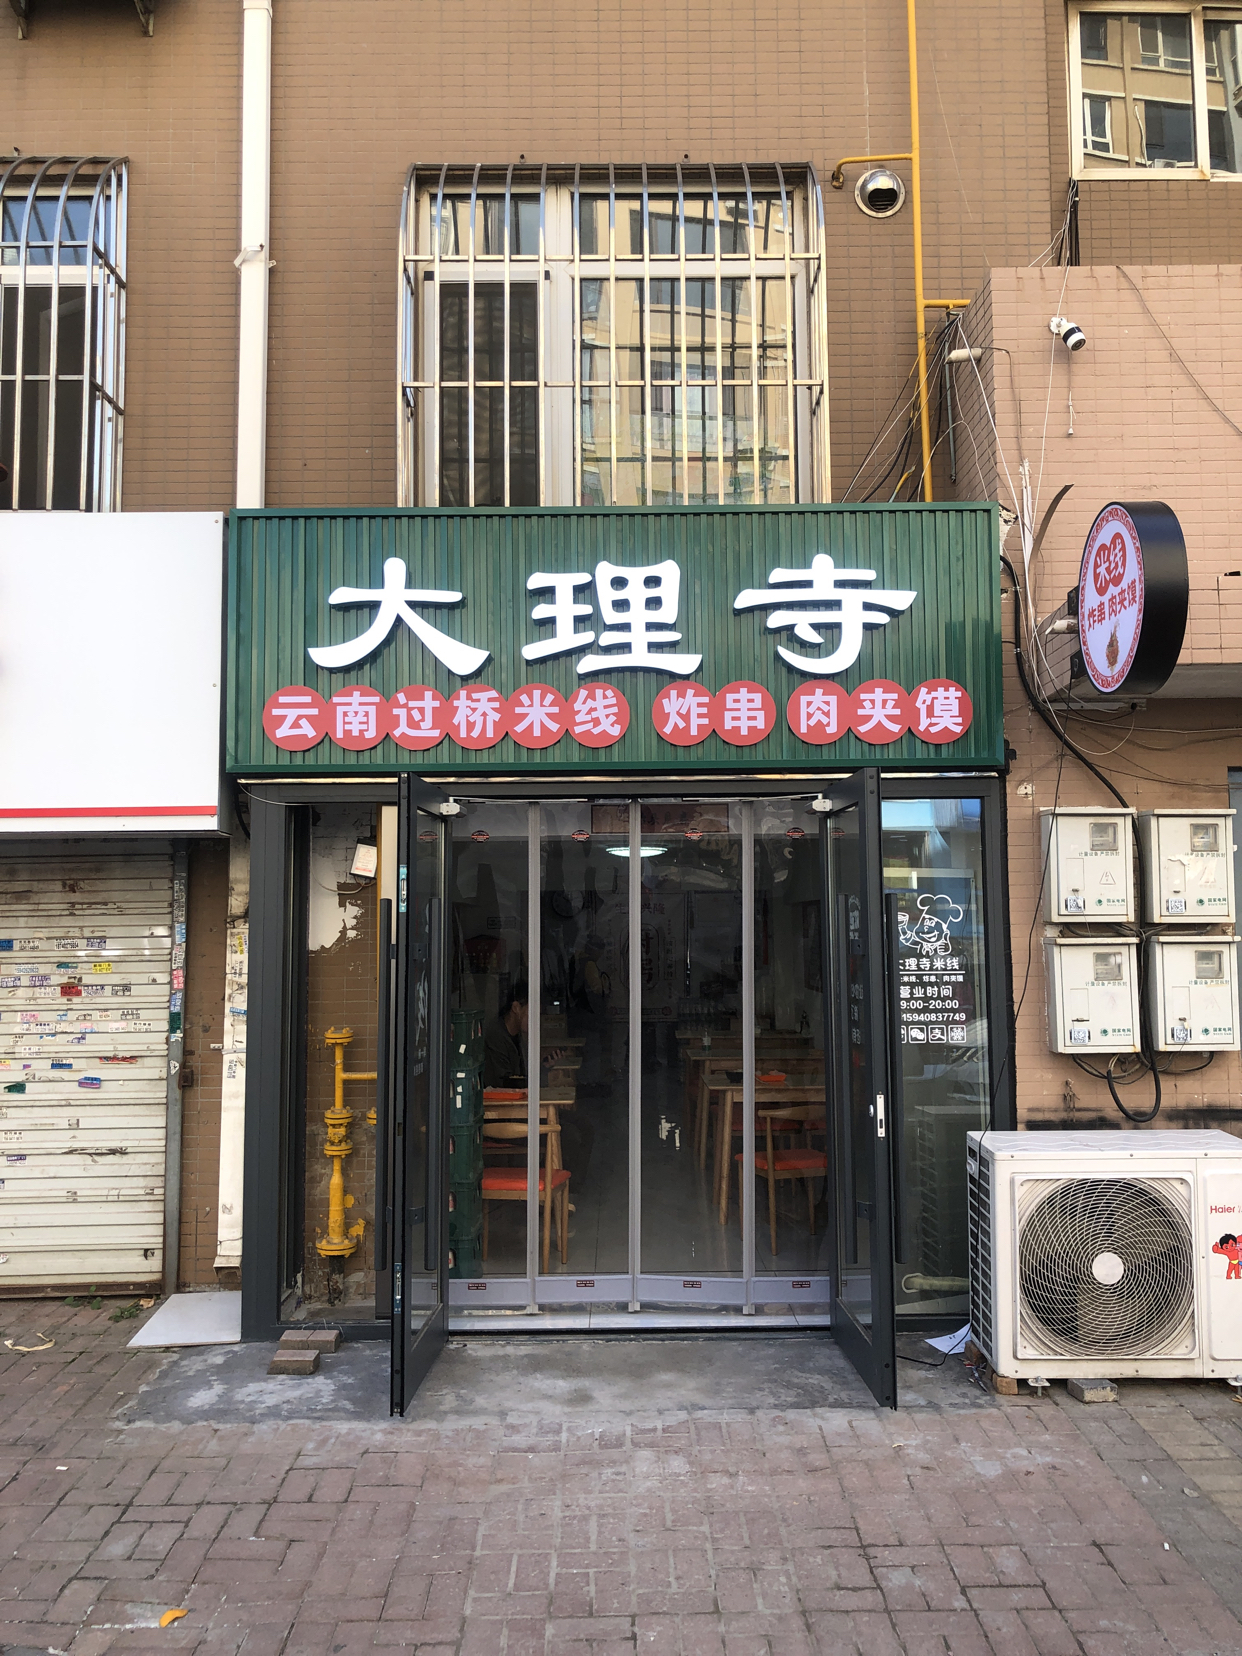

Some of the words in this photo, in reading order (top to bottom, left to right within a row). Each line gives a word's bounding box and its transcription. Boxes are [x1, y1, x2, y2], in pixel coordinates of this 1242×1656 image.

[1096, 538, 1125, 588] 米线
[308, 554, 917, 676] 大理寺
[1087, 600, 1107, 632] 炸串
[1108, 579, 1137, 621] 肉夹馍
[271, 688, 622, 740] 云南过桥米线
[661, 687, 767, 738] 炸串
[798, 686, 964, 735] 肉夹馍
[899, 985, 953, 998] 营业时间
[900, 1000, 959, 1009] 9:00-20:00
[901, 1013, 966, 1022] 15940837749
[1209, 1204, 1236, 1214] Haier
